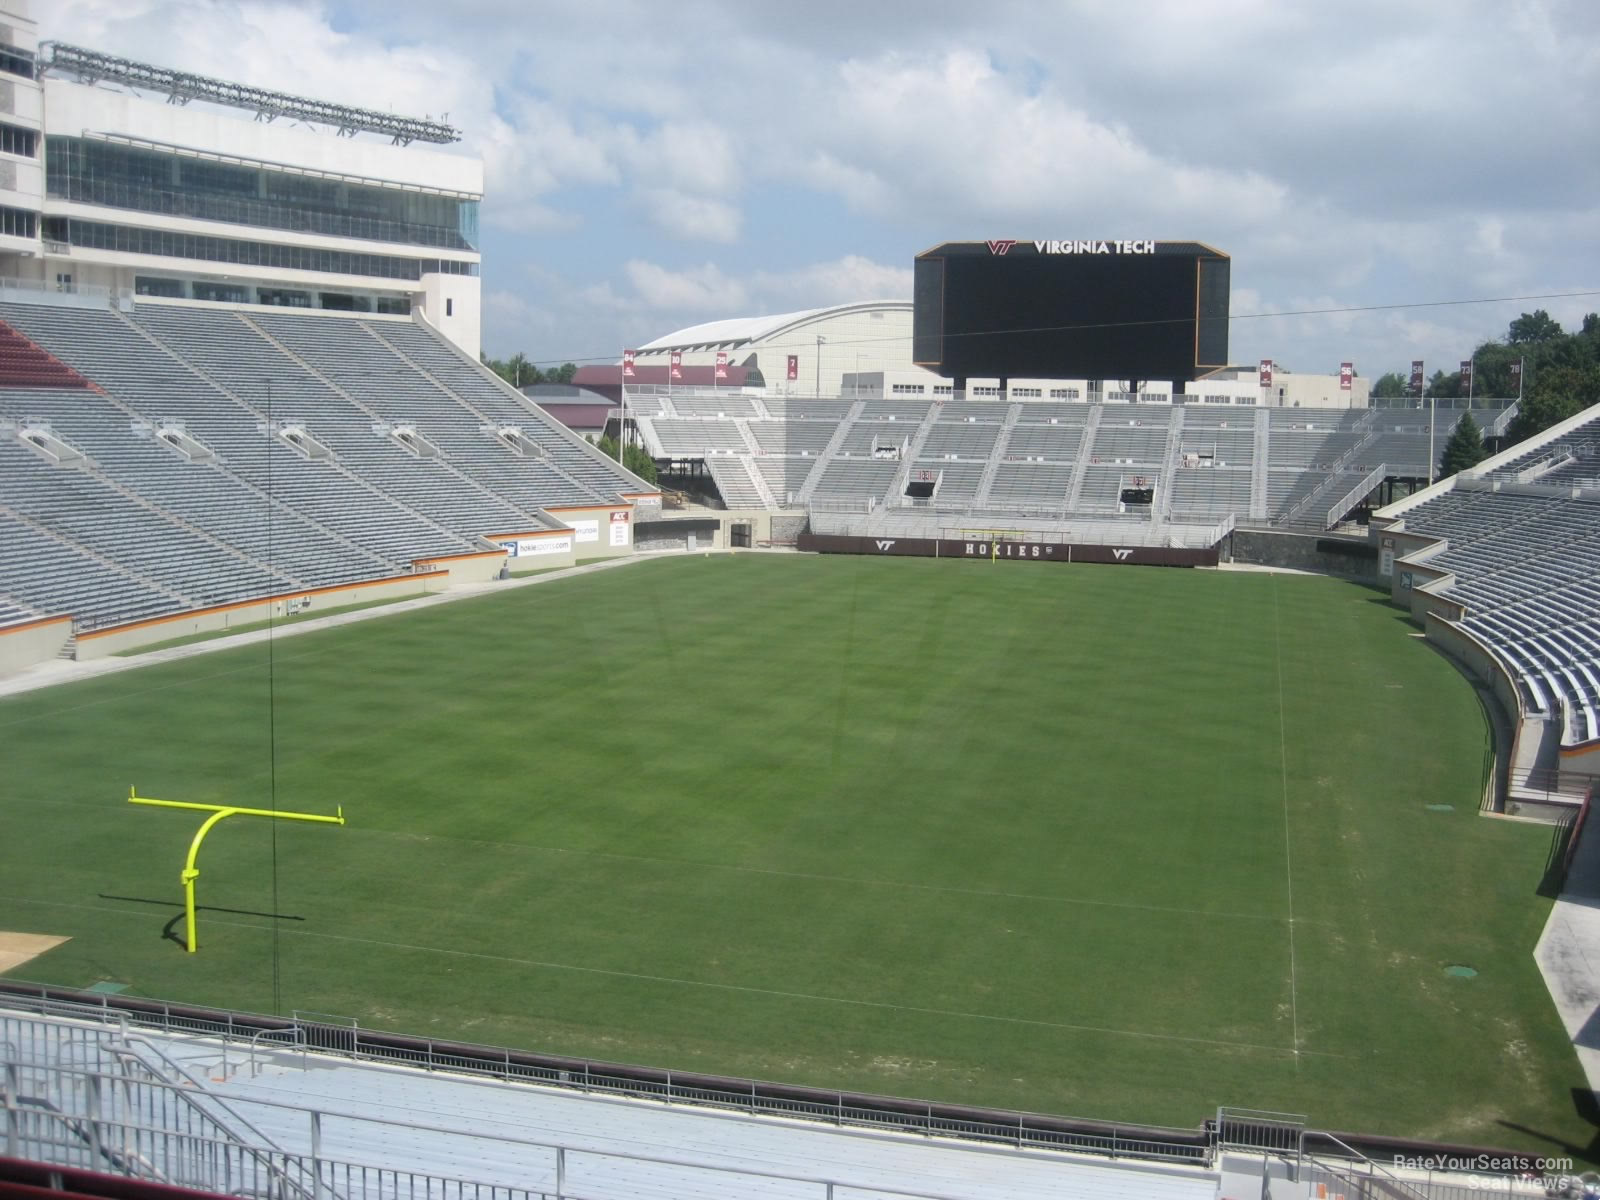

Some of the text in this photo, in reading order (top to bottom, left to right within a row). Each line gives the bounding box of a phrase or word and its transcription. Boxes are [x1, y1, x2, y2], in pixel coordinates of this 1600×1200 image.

[986, 240, 1017, 256] VT
[1033, 239, 1155, 255] VIRGINIA TECH
[672, 355, 681, 364] 10
[1261, 364, 1272, 373] 64
[1341, 367, 1352, 375] 56
[1461, 367, 1471, 375] 73
[1509, 364, 1520, 374] 78
[612, 512, 626, 521] ACC
[519, 541, 569, 553] hokiesports.com
[876, 540, 896, 551] VT
[965, 543, 1041, 557] HOKIES
[1112, 548, 1134, 560] VT
